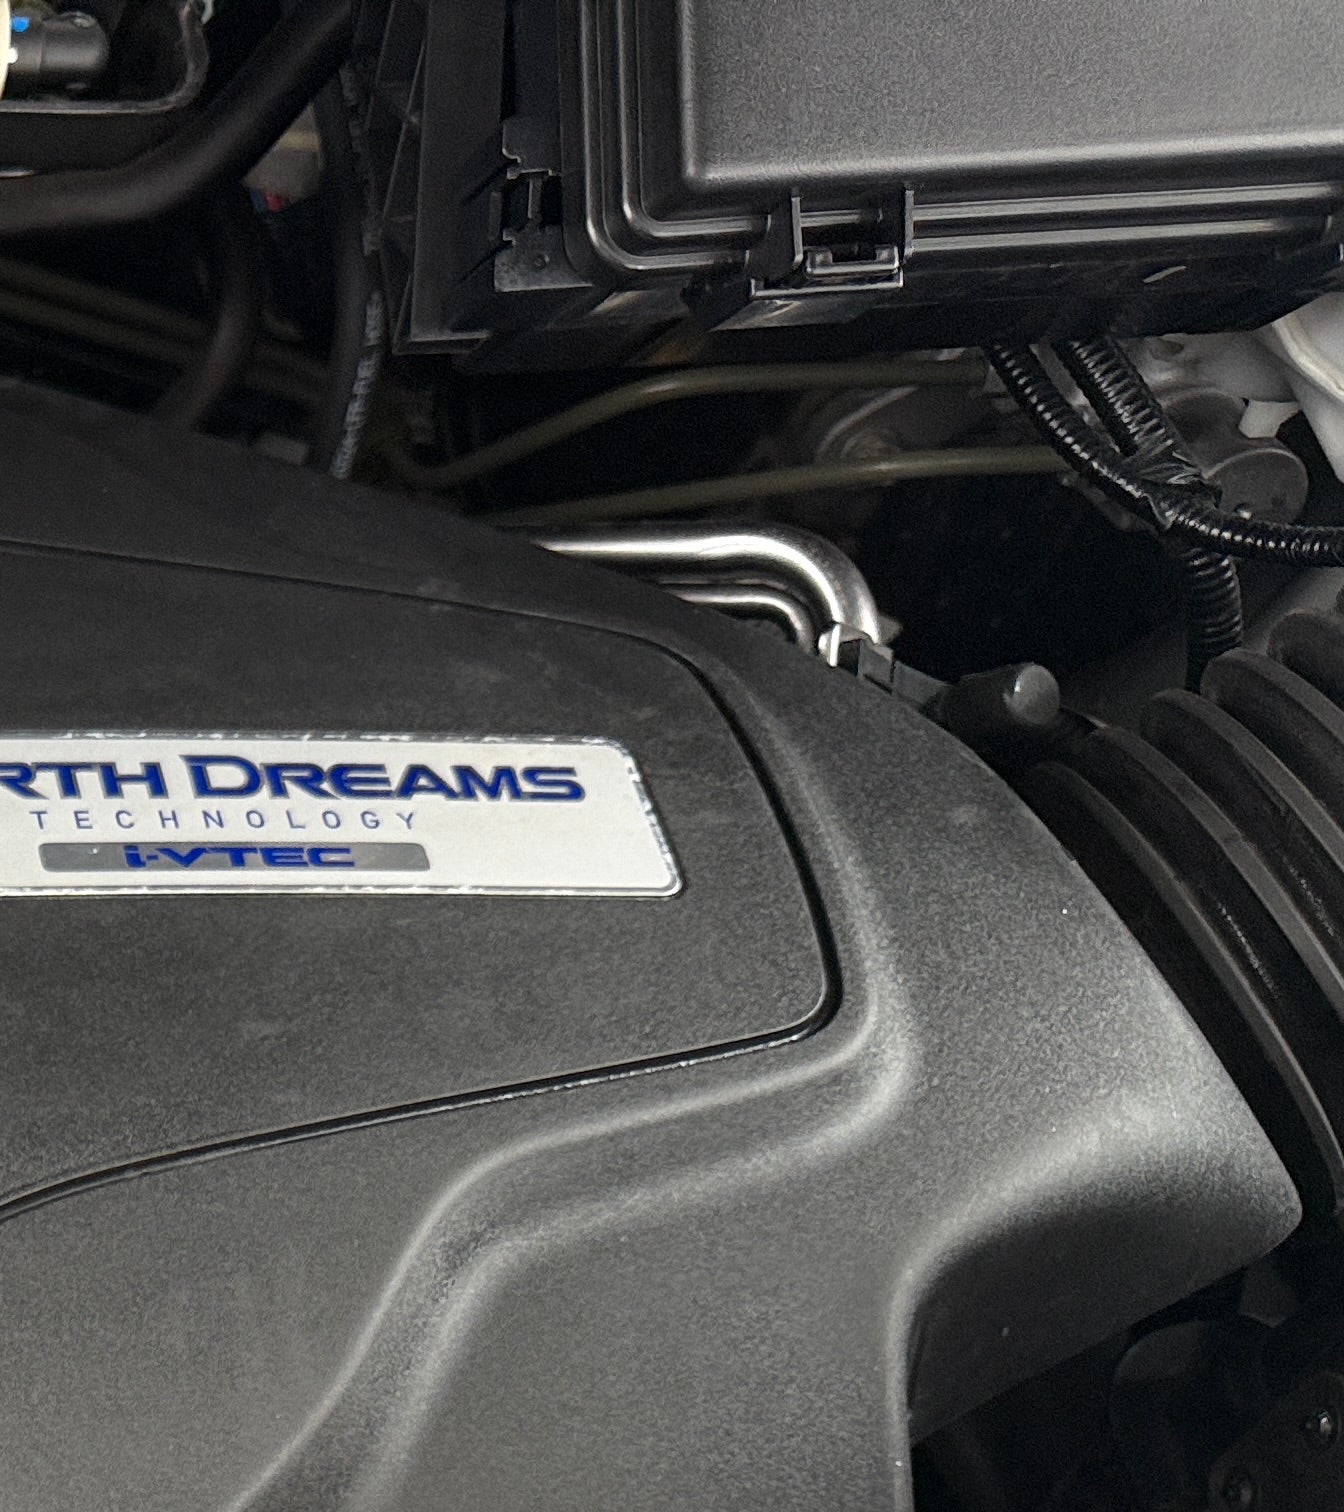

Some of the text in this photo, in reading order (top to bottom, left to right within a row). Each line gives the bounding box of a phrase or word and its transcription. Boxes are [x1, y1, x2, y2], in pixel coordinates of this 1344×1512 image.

[179, 754, 585, 802] DREAMS
[29, 810, 416, 830] TECHNOLOGY
[124, 845, 355, 868] i-VTEC
